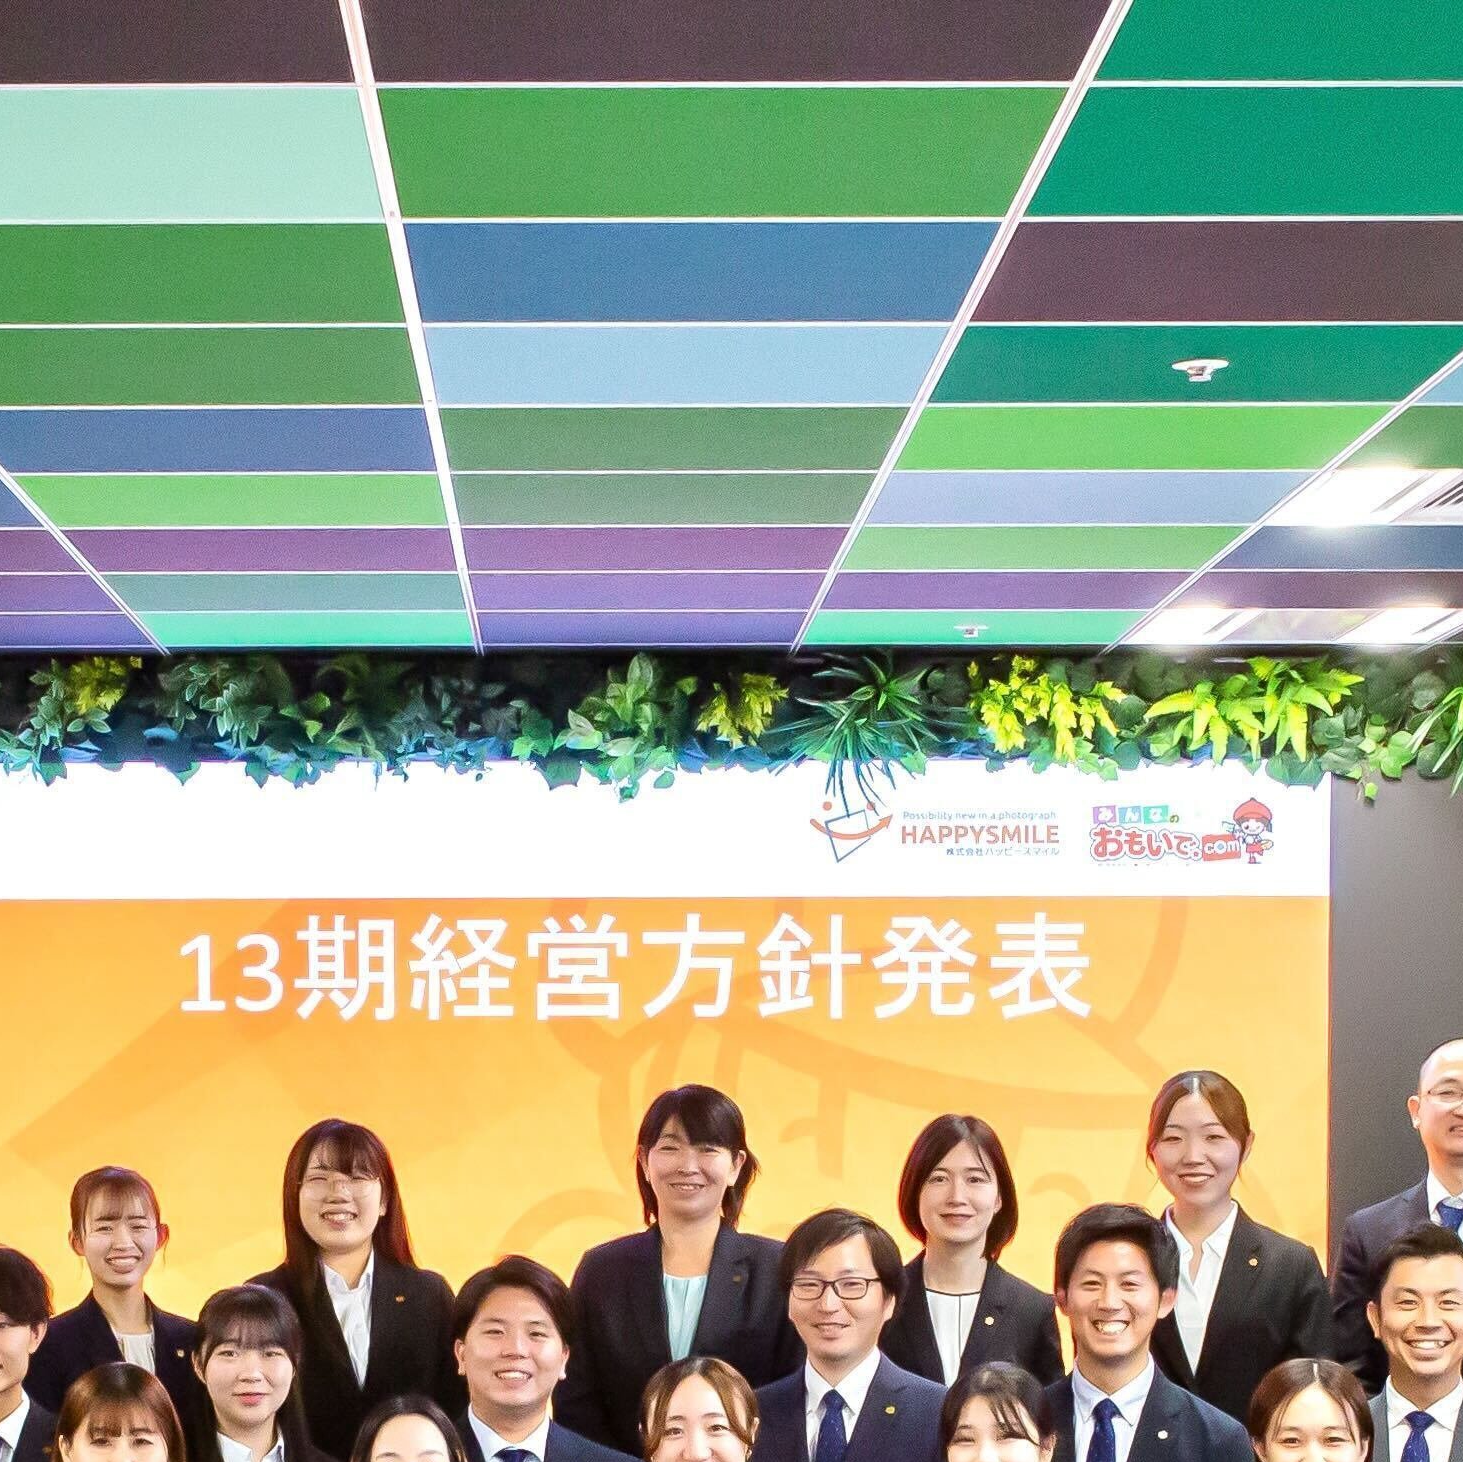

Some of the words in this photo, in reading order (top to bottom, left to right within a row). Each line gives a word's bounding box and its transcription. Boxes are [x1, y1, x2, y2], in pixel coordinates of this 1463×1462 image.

[998, 811, 1057, 821] photograph
[901, 825, 1060, 845] HAPPYSMILE
[178, 914, 1091, 1021] 13期経営方針発表
